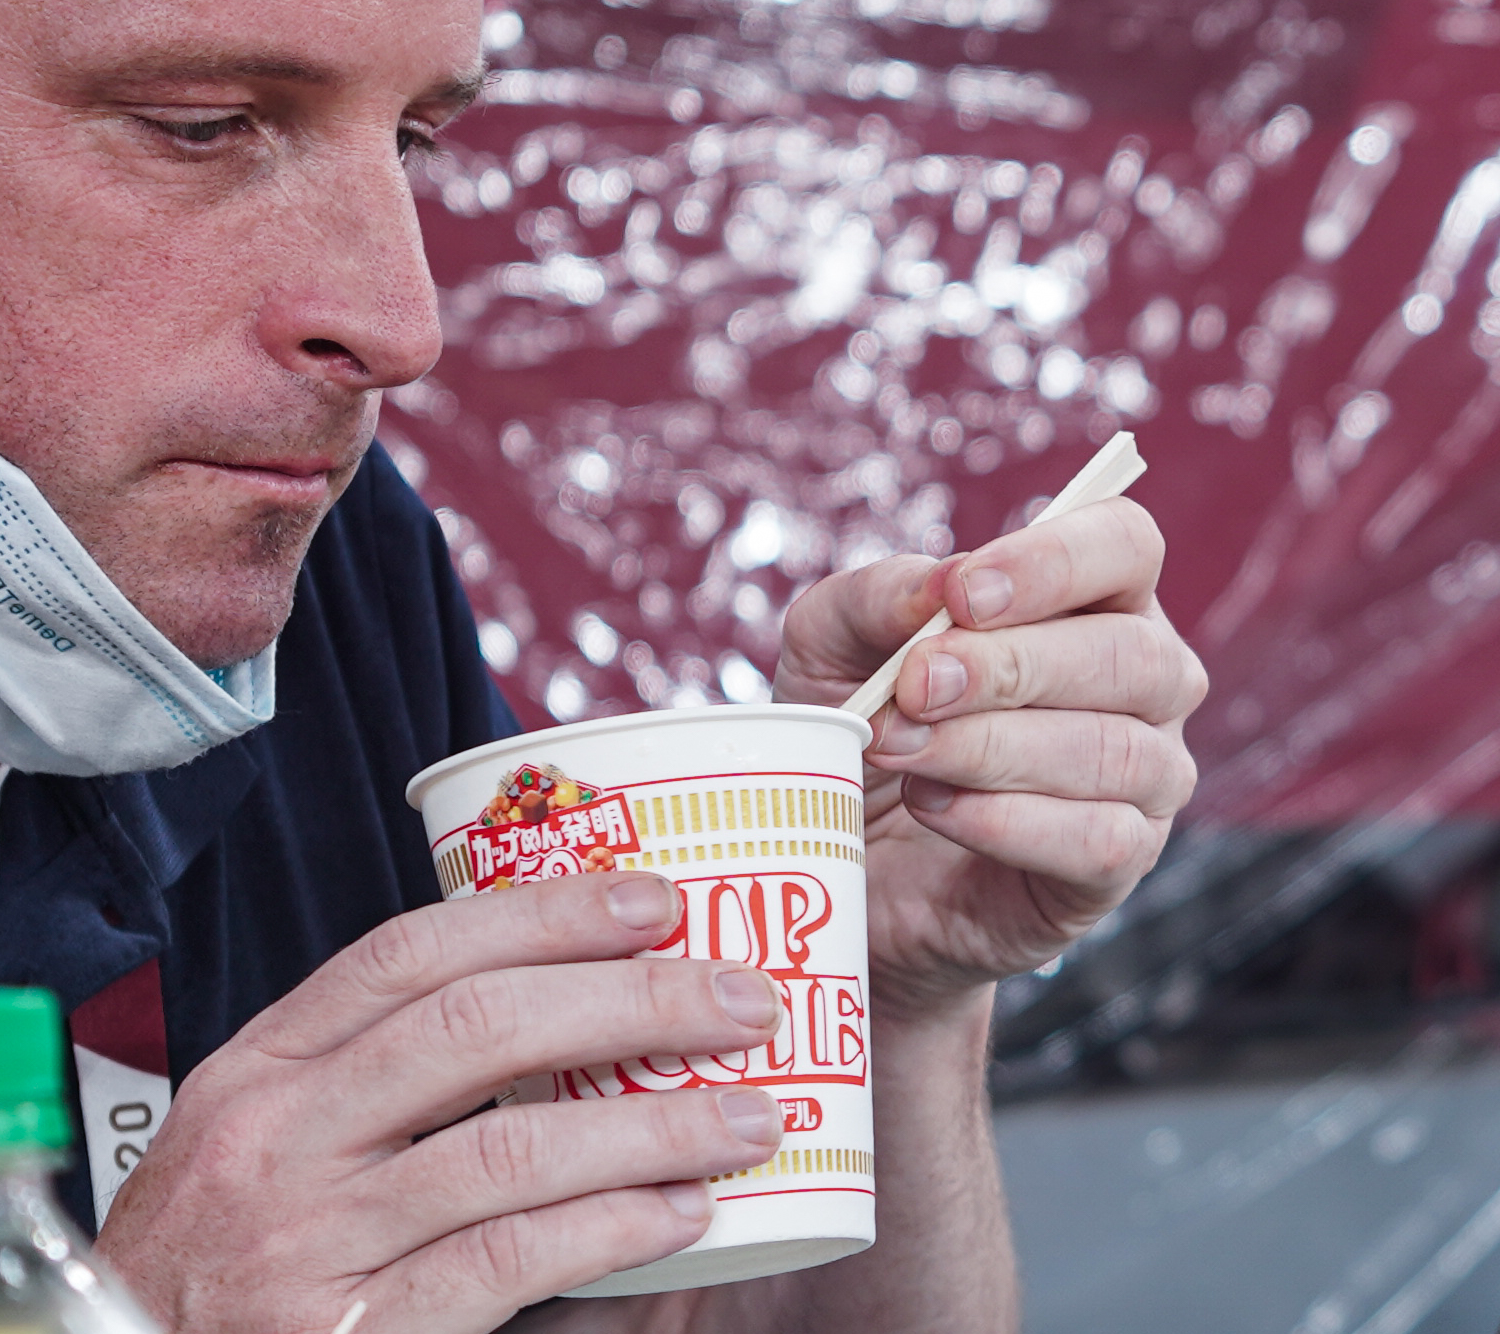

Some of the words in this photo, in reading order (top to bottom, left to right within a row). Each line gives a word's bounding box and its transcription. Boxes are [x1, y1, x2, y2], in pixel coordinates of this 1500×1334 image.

[471, 799, 632, 882] カップめん発明
